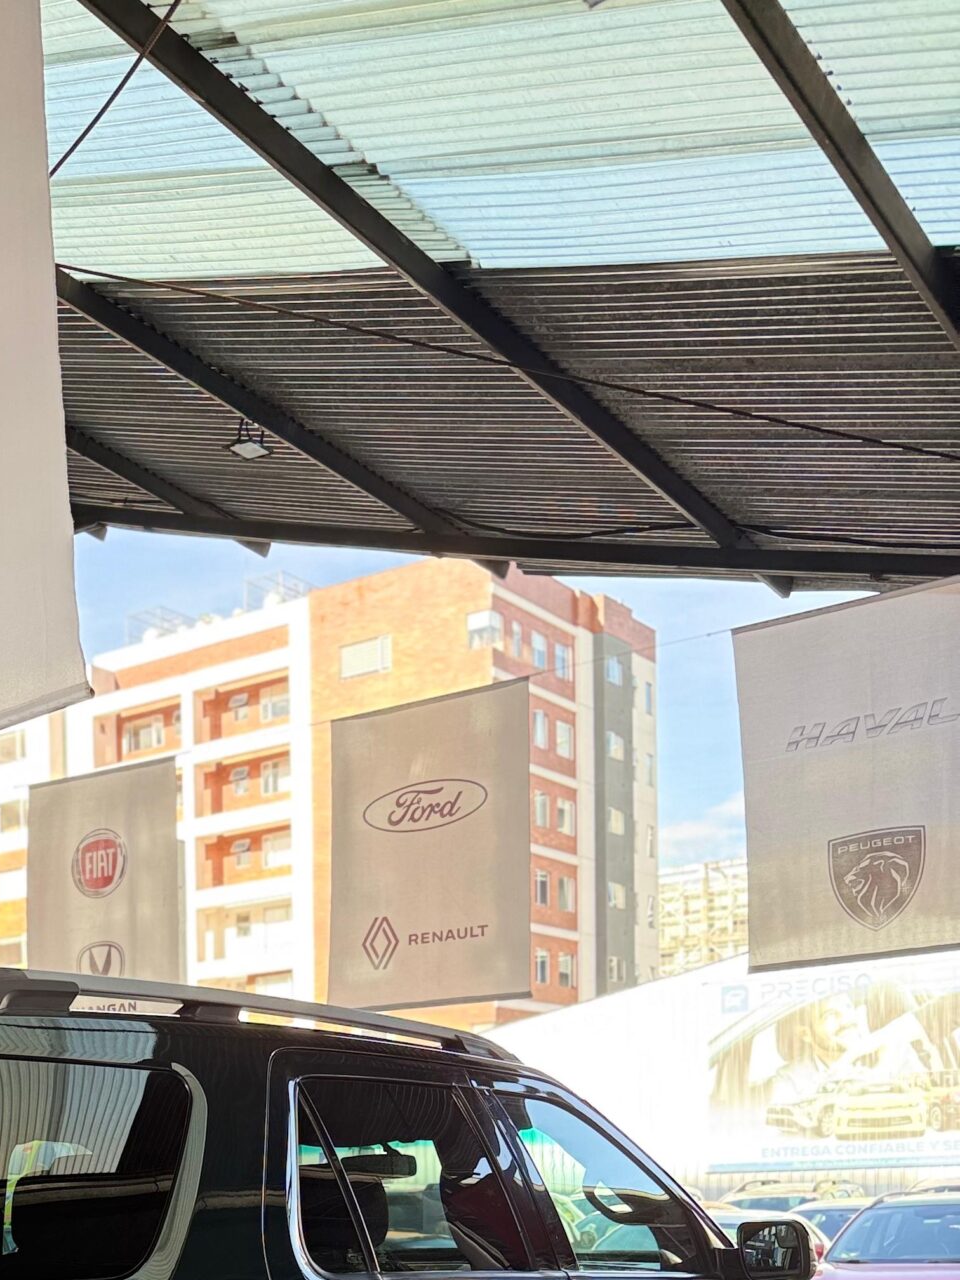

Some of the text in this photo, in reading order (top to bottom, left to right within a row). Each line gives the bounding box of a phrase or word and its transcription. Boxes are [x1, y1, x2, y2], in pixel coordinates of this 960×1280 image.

[387, 786, 463, 827] Ford
[837, 835, 916, 855] PEUGEOT
[85, 847, 116, 880] FIAT
[408, 924, 489, 946] RENAULT
